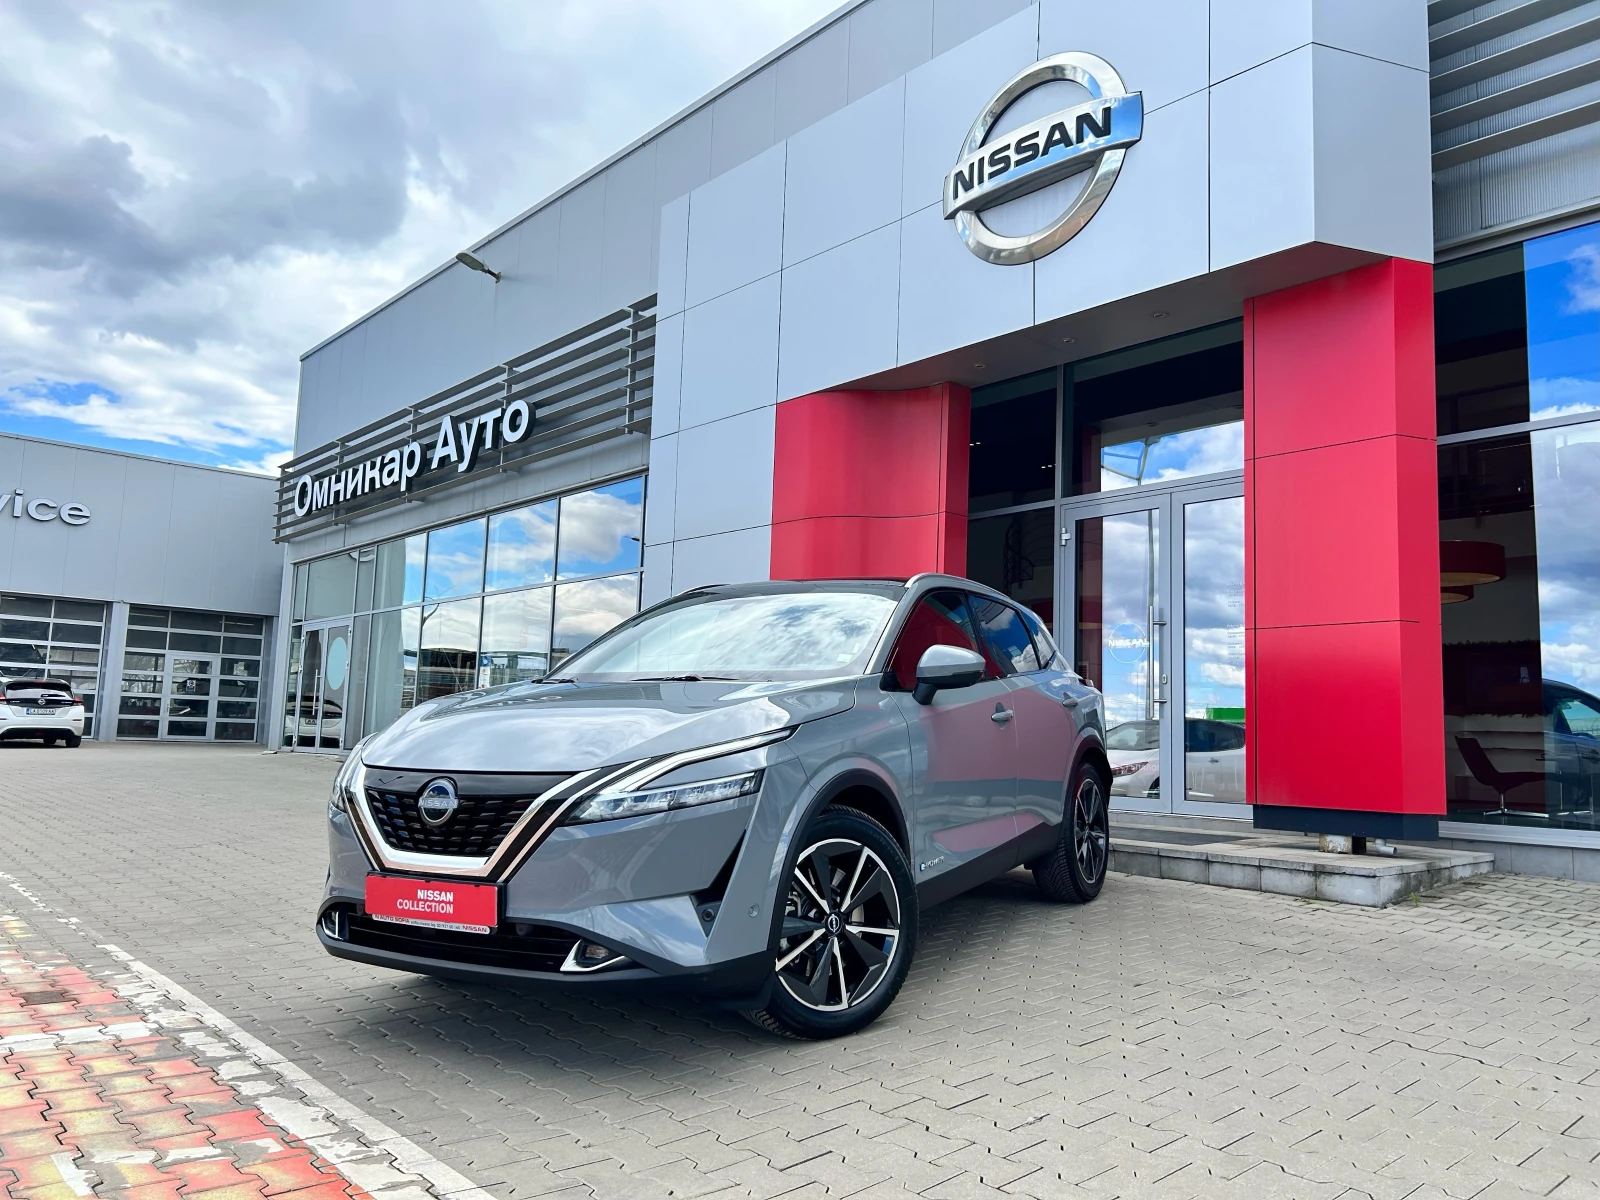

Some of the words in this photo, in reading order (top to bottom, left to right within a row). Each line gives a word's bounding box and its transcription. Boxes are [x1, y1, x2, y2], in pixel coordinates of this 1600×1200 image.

[952, 106, 1112, 201] NISSAN
[294, 442, 424, 517] Омникар
[431, 400, 533, 473] Ауто
[418, 799, 457, 807] NISSAN
[417, 889, 454, 902] NISSAN
[396, 899, 454, 914] COLLECTION
[462, 925, 487, 933] NISSAN
